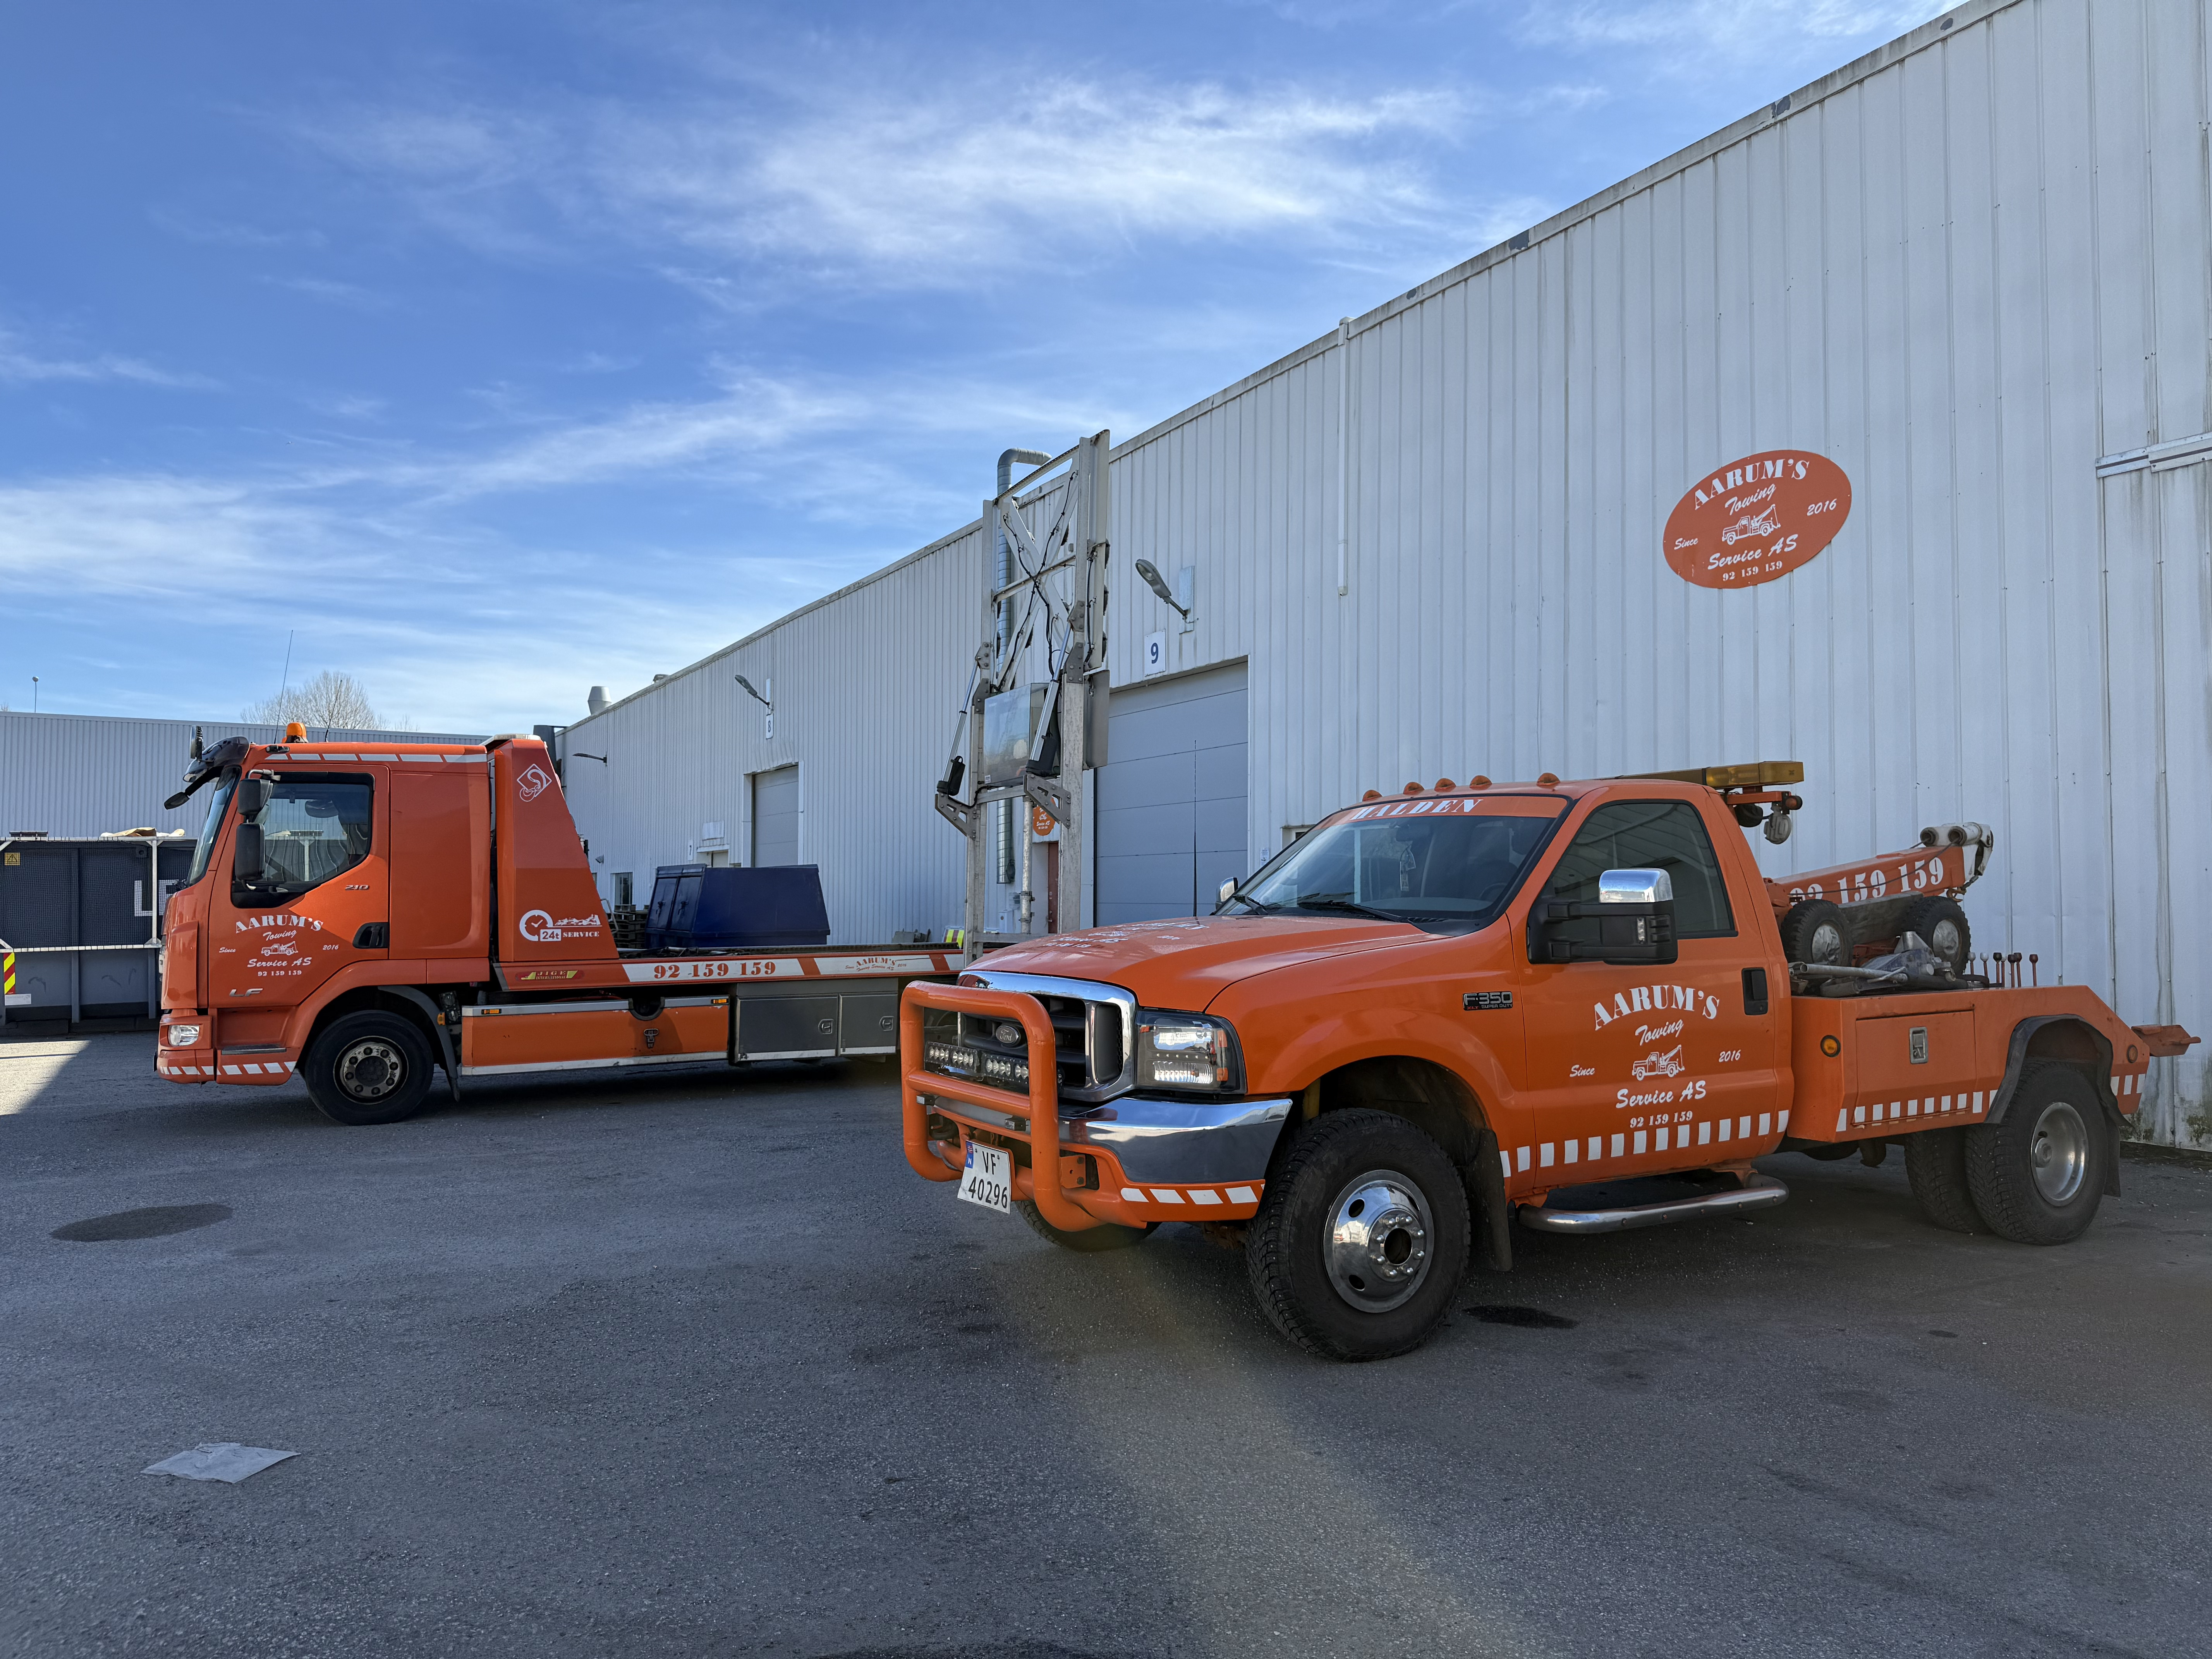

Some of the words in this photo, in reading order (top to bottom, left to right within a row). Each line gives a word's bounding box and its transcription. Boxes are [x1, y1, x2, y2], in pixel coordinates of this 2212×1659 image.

[1695, 459, 1810, 510] AARUM'S
[1724, 483, 1777, 515] Towing
[1807, 498, 1837, 516] 2016
[1674, 538, 1698, 550] Since
[1708, 549, 1762, 570] Service
[1768, 534, 1798, 556] AS
[1723, 572, 1735, 581] 92
[1741, 566, 1759, 578] 159
[1765, 560, 1783, 572] 159
[1151, 642, 1159, 664] 9
[768, 720, 771, 733] 8
[1350, 799, 1484, 820] HALDEN
[1838, 870, 1886, 904] 159
[1898, 857, 1943, 892] 159
[236, 915, 323, 933] AARUM'S
[263, 930, 297, 941] Towing
[543, 931, 560, 939] 24t
[247, 959, 288, 967] Service
[292, 957, 312, 966] AS
[654, 965, 680, 979] 92
[692, 963, 729, 977] 159
[740, 962, 776, 975] 159
[229, 988, 263, 997] LF
[1594, 985, 1719, 1031] AARUM'S
[1000, 1029, 1012, 1041] Ford
[1635, 1019, 1684, 1046] Towing
[1719, 1049, 1741, 1062] 2016
[1570, 1065, 1595, 1077] Since
[1616, 1089, 1673, 1108] Service
[1680, 1080, 1706, 1102] AS
[1630, 1117, 1644, 1128] 92
[1649, 1113, 1669, 1125] 159
[1673, 1111, 1693, 1122] 159
[982, 1151, 996, 1175] VF
[968, 1176, 1008, 1209] 40296
